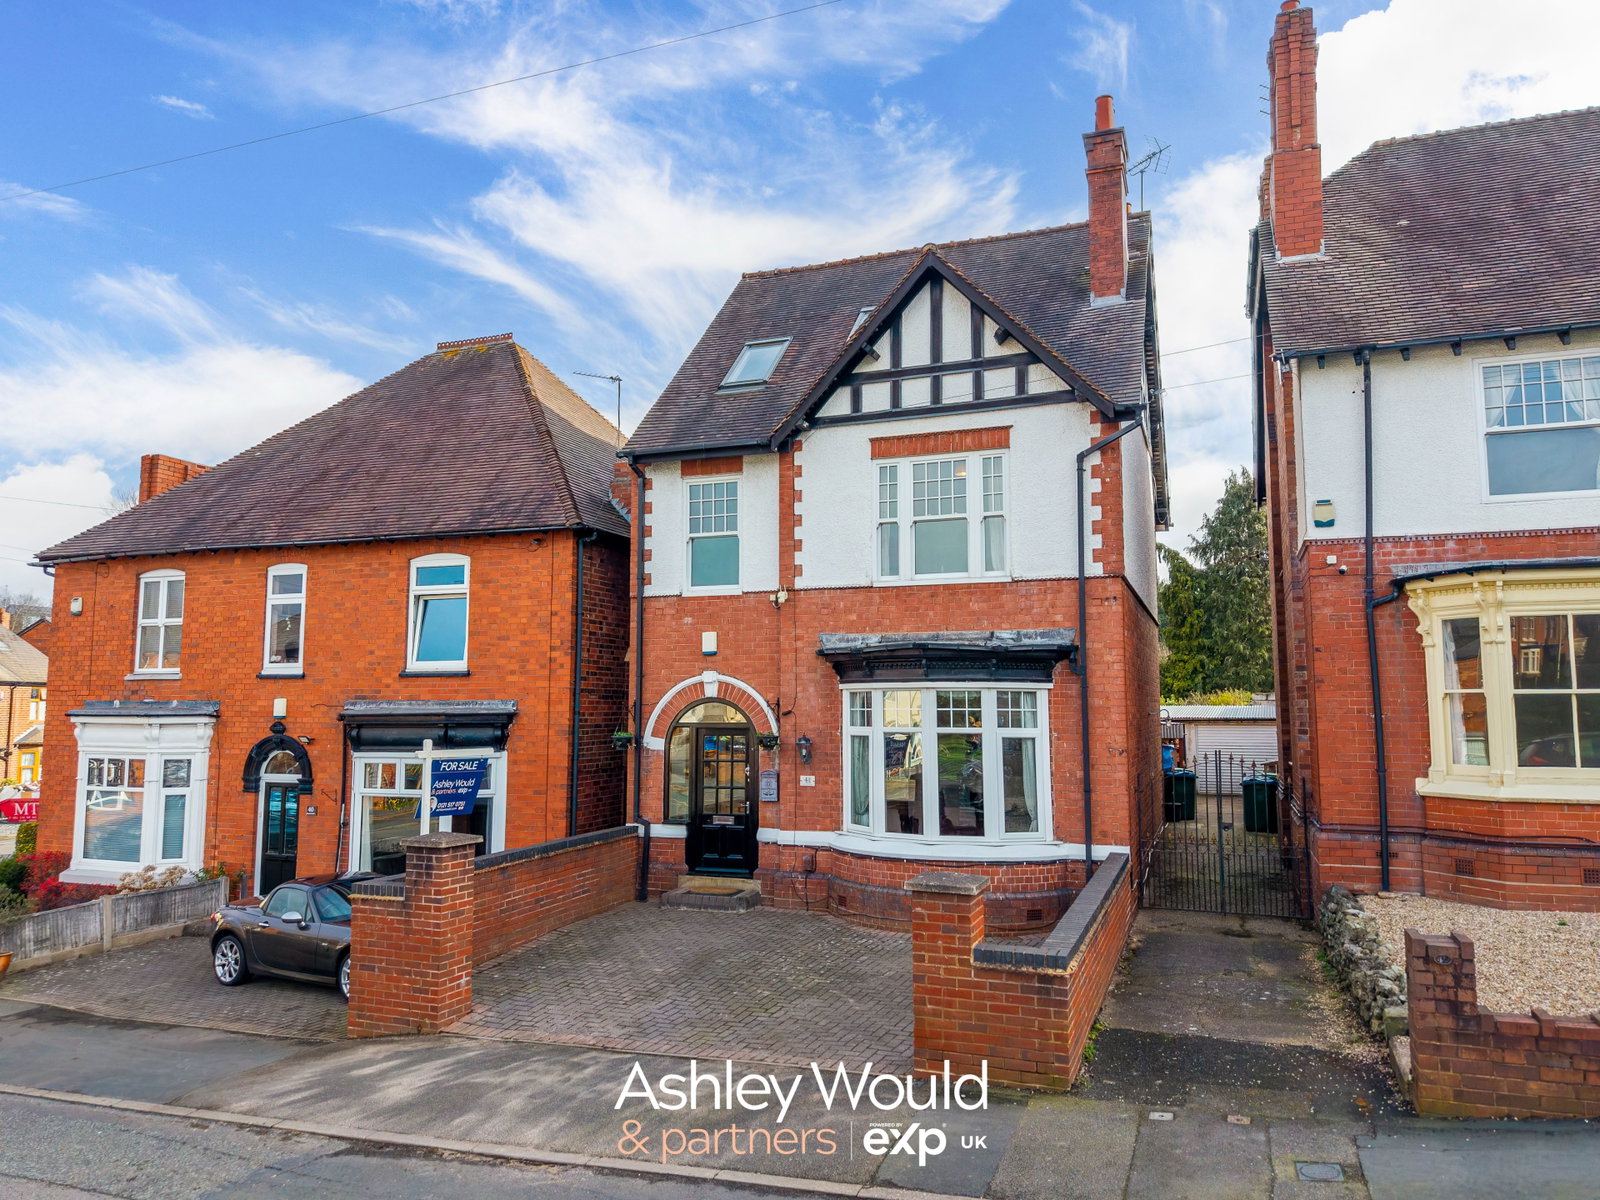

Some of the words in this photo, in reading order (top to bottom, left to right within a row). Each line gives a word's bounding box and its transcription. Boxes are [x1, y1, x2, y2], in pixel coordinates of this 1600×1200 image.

[440, 761, 458, 771] FOR
[458, 761, 479, 770] SALE
[432, 779, 455, 790] Ashley
[455, 778, 476, 787] Would
